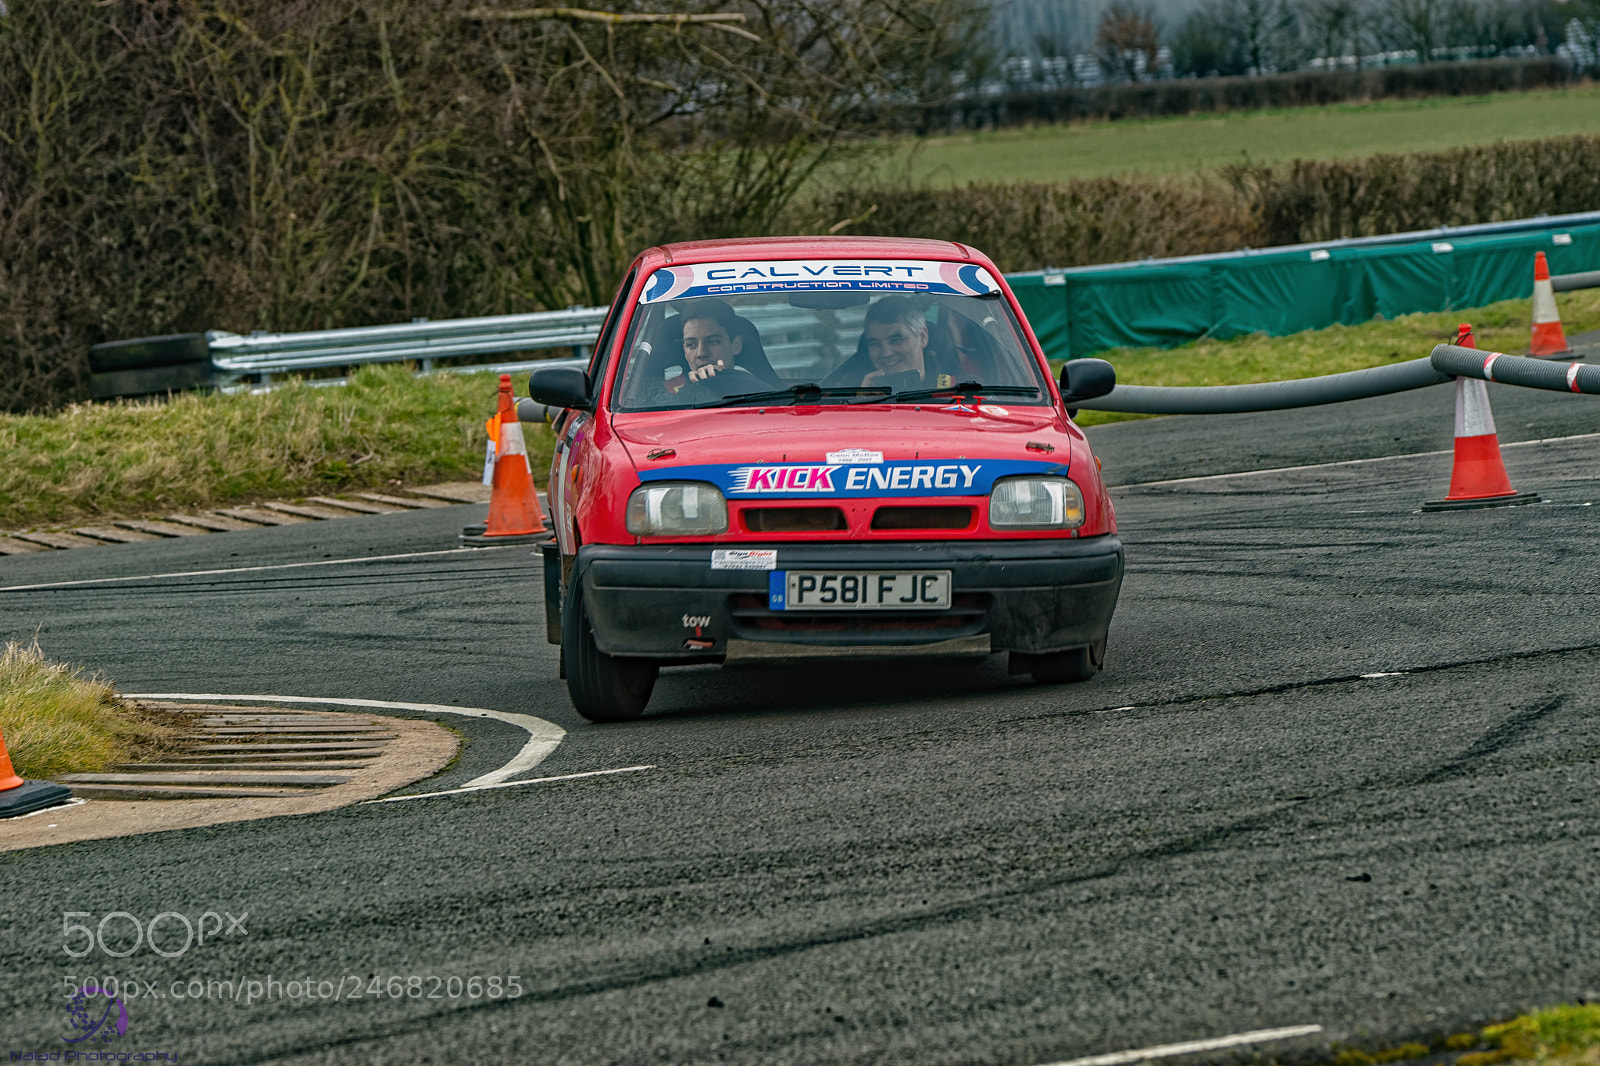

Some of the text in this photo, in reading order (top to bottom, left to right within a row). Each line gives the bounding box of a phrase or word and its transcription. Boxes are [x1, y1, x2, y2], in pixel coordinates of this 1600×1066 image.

[707, 265, 924, 281] CALVERT
[707, 281, 929, 293] CONSTRUCTION LIMITED
[744, 465, 982, 492] KICK ENERGY
[797, 574, 939, 603] P581 FJC
[682, 614, 711, 628] tow
